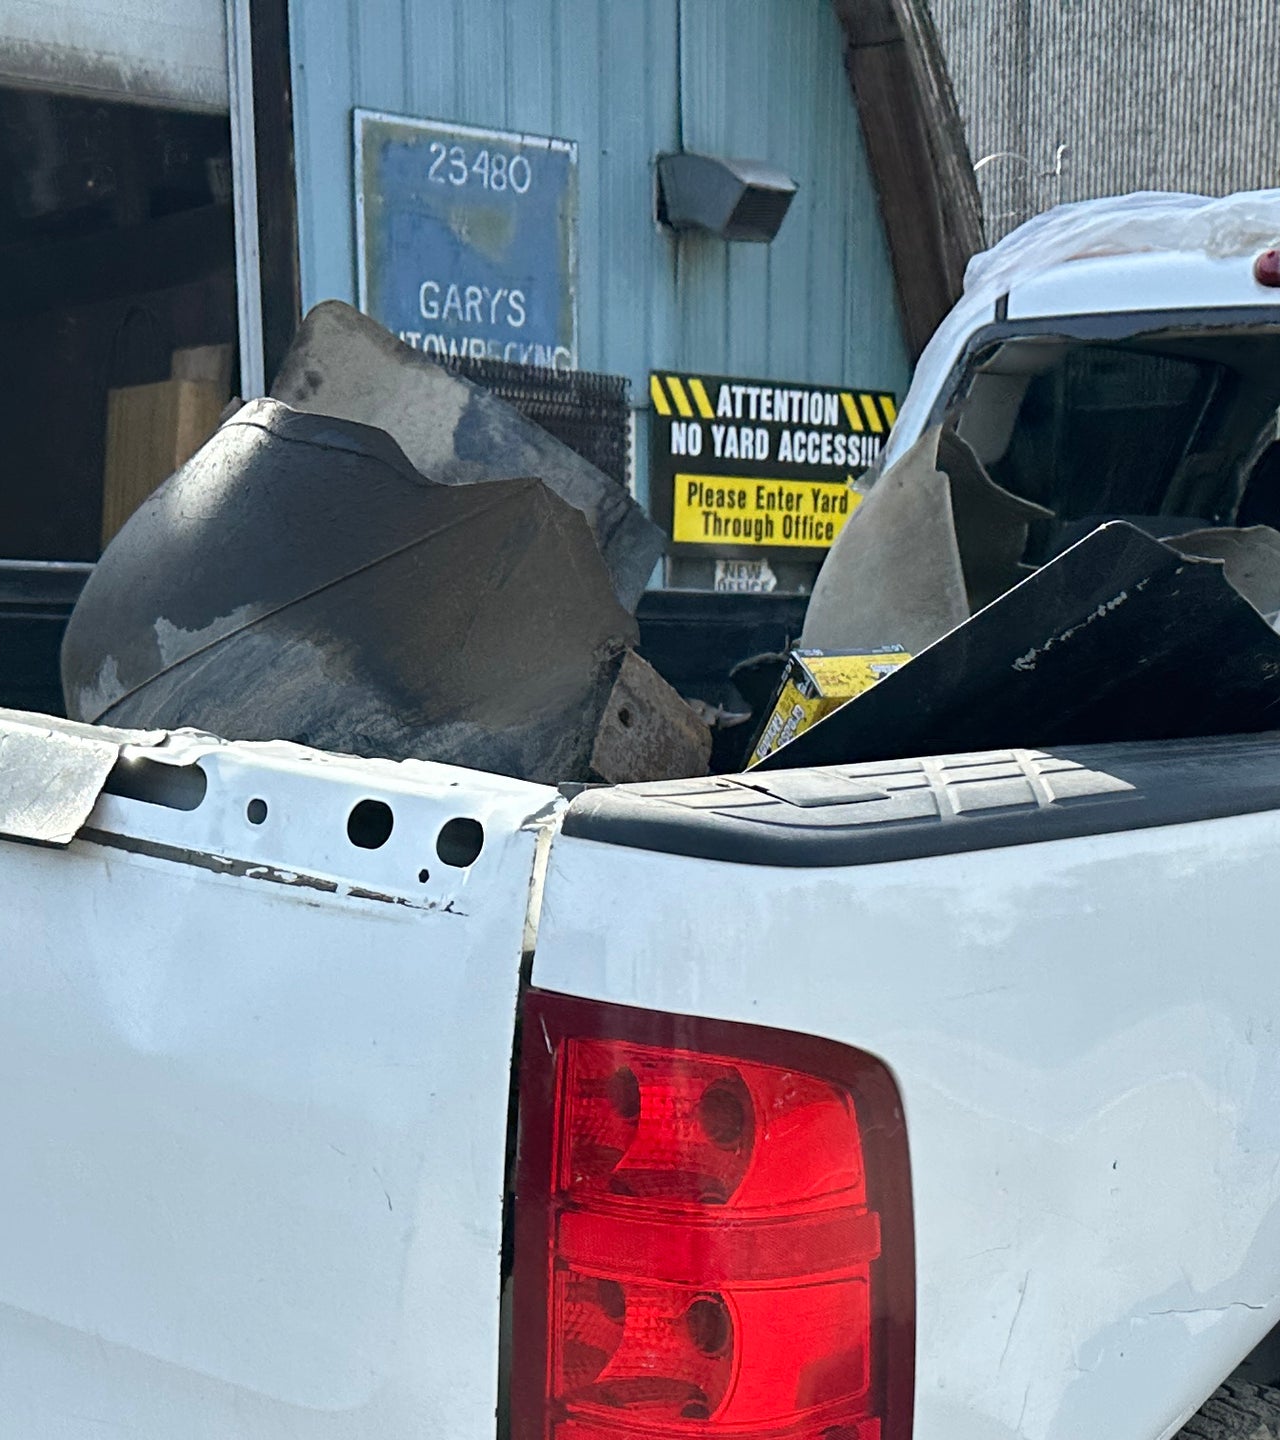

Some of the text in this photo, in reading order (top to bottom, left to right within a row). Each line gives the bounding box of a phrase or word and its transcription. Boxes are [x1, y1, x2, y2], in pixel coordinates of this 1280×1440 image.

[428, 142, 531, 194] 23480
[420, 280, 526, 327] GARY'S
[717, 384, 839, 426] ATTENTION
[671, 420, 702, 456] NO
[711, 424, 770, 460] YARD
[687, 481, 849, 514] Please Enter Yard
[701, 511, 834, 542] Through Office
